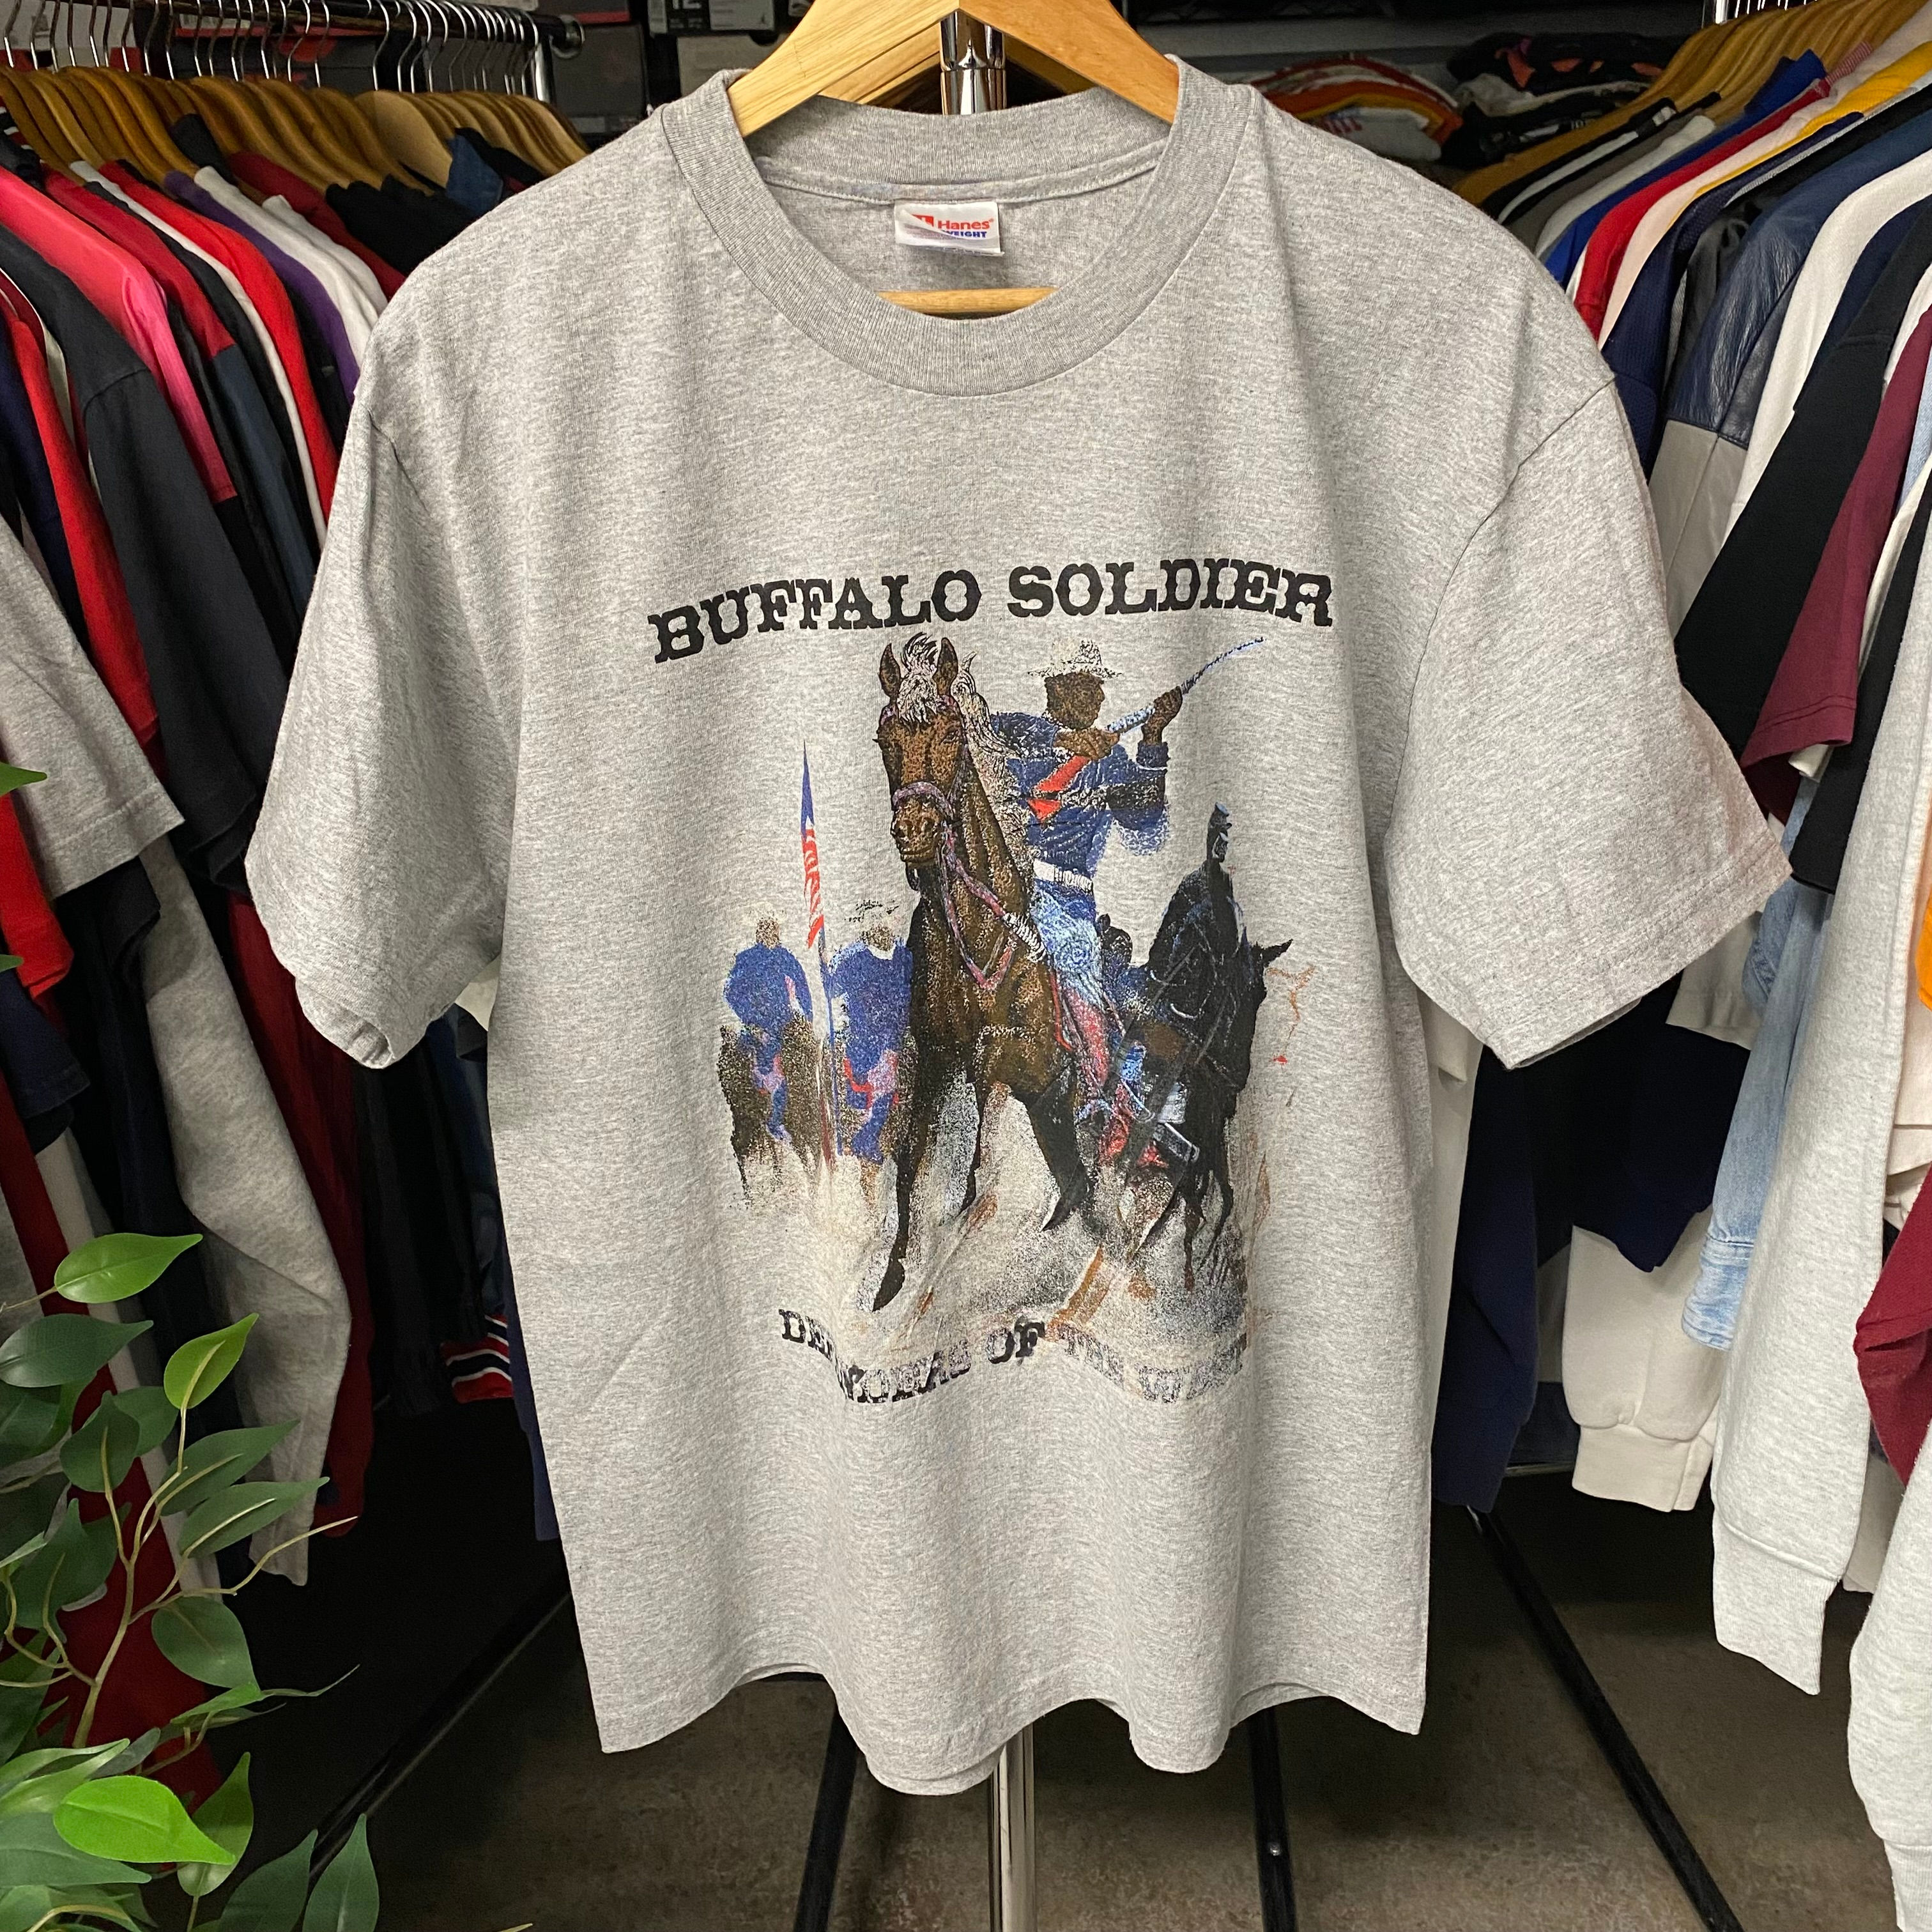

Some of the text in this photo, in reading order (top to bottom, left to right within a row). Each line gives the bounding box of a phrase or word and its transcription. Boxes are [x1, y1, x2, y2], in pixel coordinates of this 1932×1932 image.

[937, 220, 990, 229] Hanes
[647, 558, 1333, 663] BUFFALO SOLDIER
[985, 1319, 1045, 1364] OF
